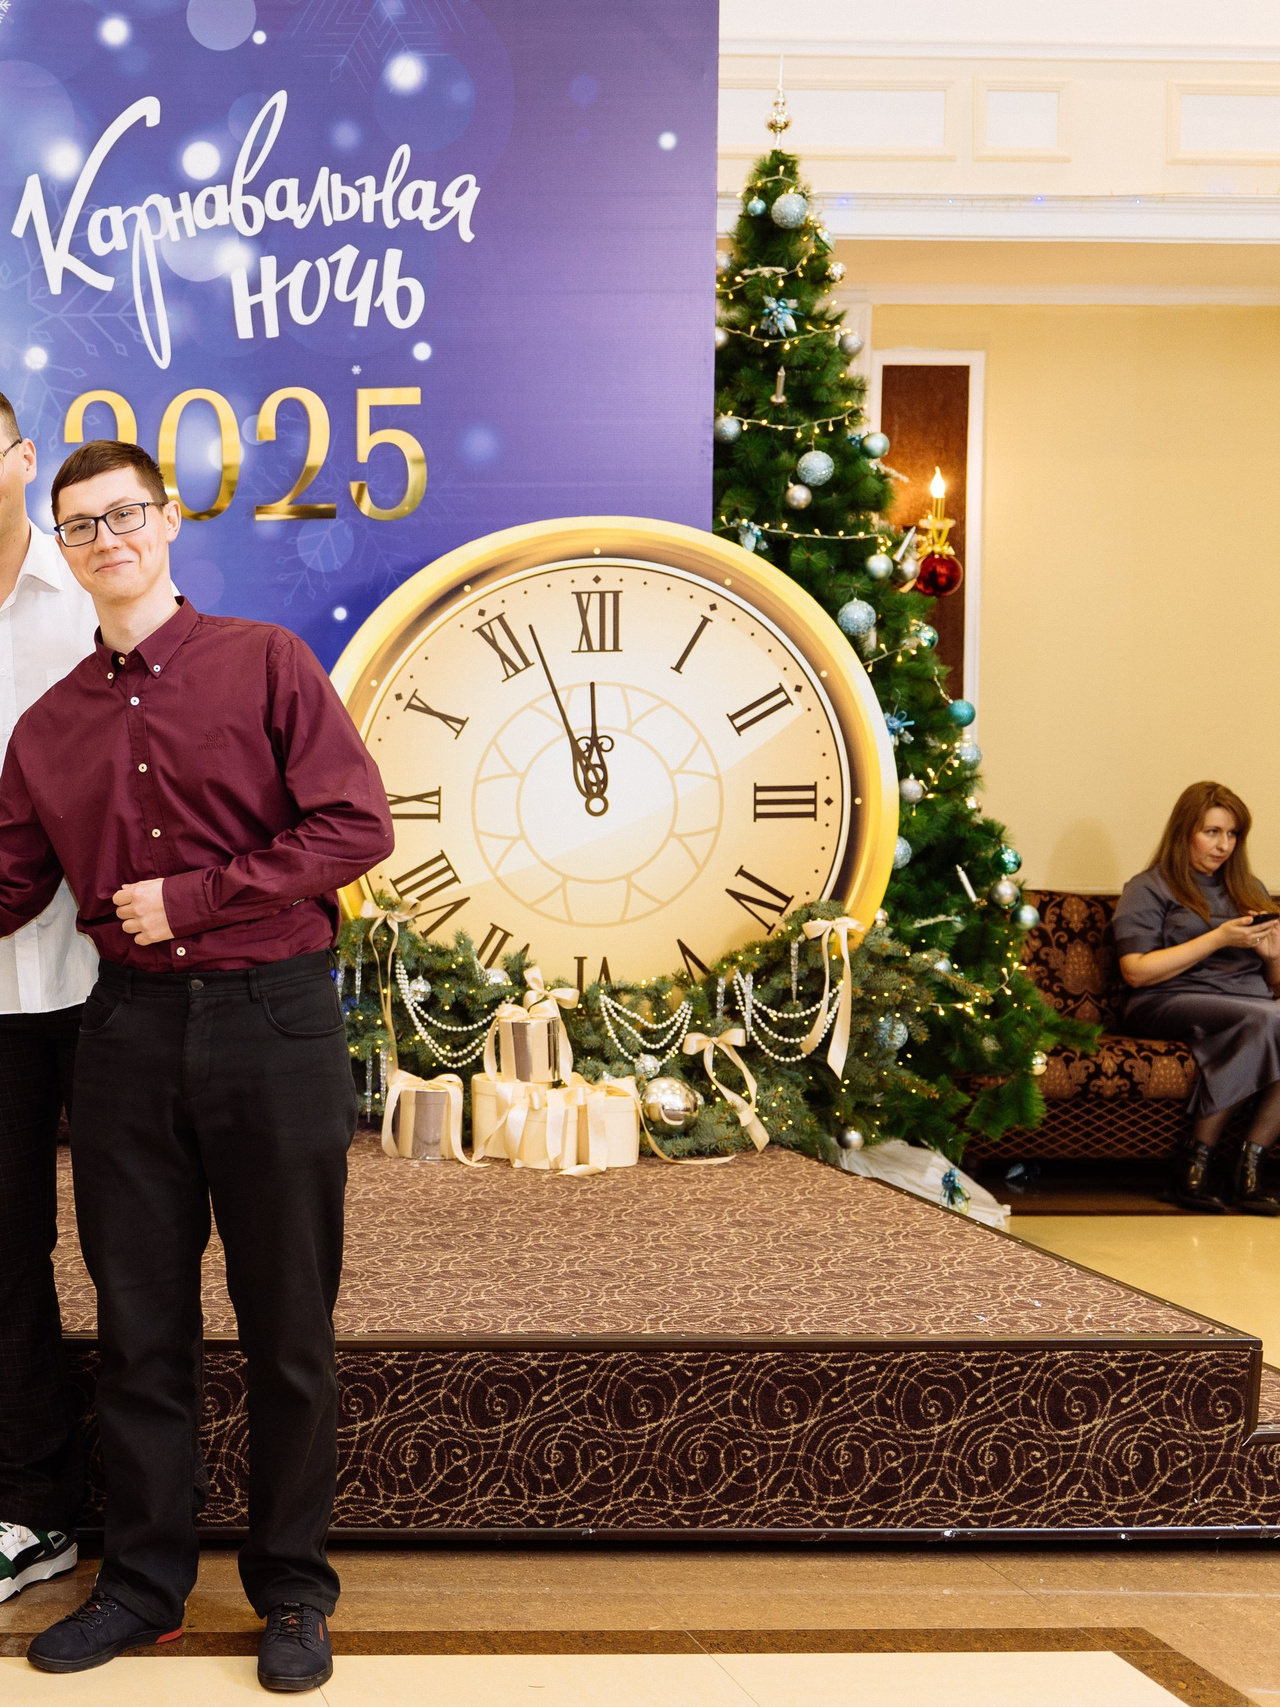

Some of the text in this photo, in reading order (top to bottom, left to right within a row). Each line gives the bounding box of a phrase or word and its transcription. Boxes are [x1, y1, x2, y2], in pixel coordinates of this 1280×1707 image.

[11, 89, 481, 370] Карнавальная
[472, 611, 535, 682] XI
[571, 590, 623, 653] XII
[404, 688, 469, 740] X
[726, 682, 794, 736] II
[753, 781, 818, 822] III
